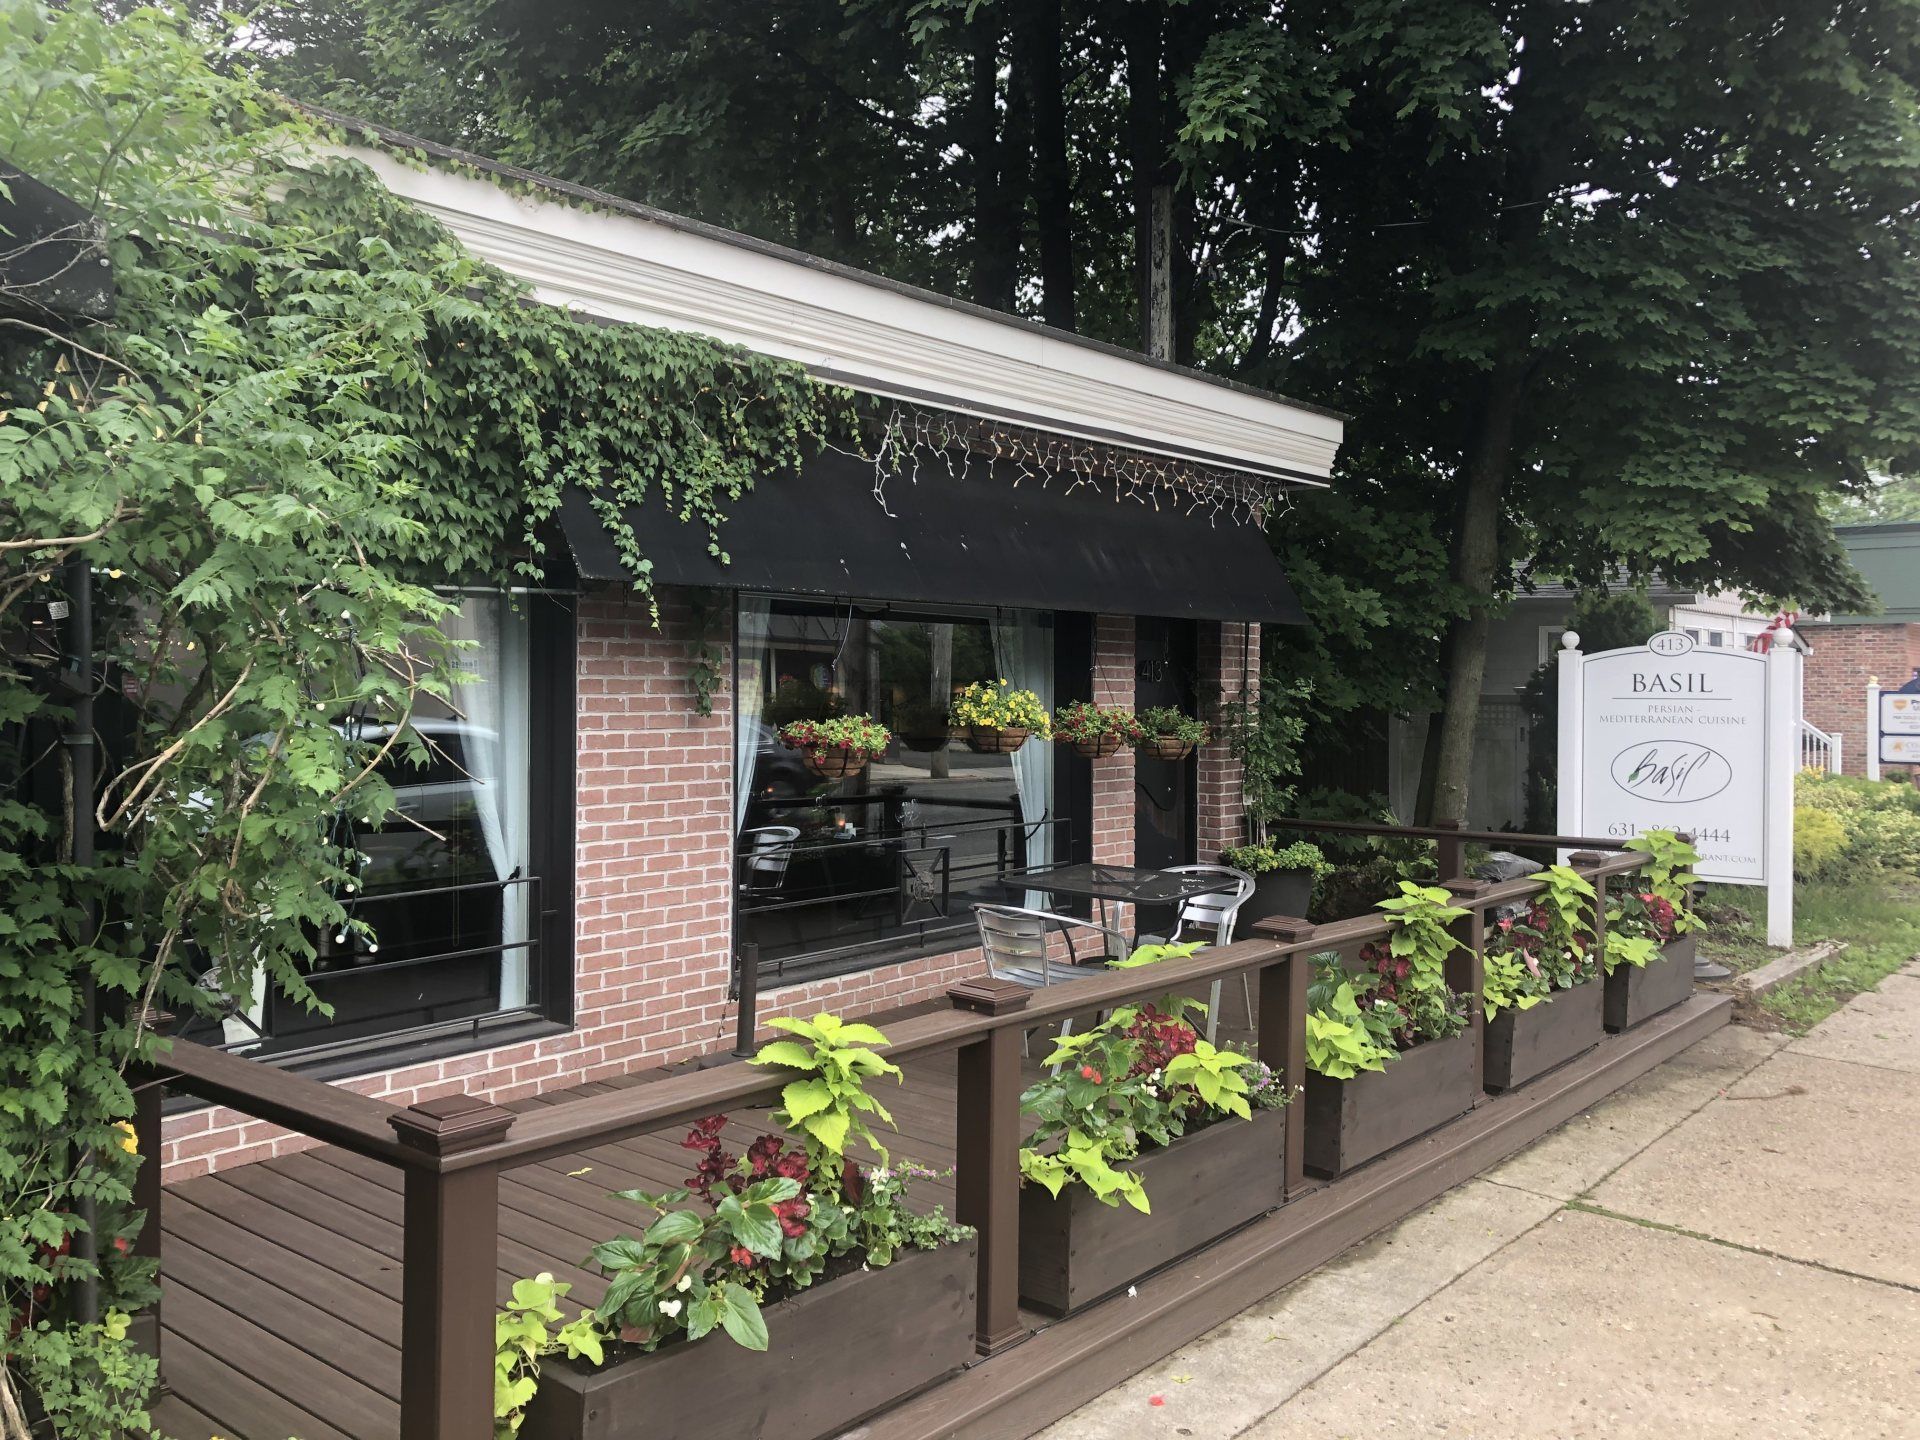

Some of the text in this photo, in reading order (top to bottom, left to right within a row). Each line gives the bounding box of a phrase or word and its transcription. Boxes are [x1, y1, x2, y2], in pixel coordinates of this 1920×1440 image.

[1656, 638, 1684, 651] 413
[1141, 660, 1163, 682] 413
[1631, 673, 1713, 693] BASIL
[1648, 704, 1693, 713] PERSIAN
[1599, 715, 1748, 725] MEDITERRANEAN CUISINE
[1627, 748, 1711, 796] Basil
